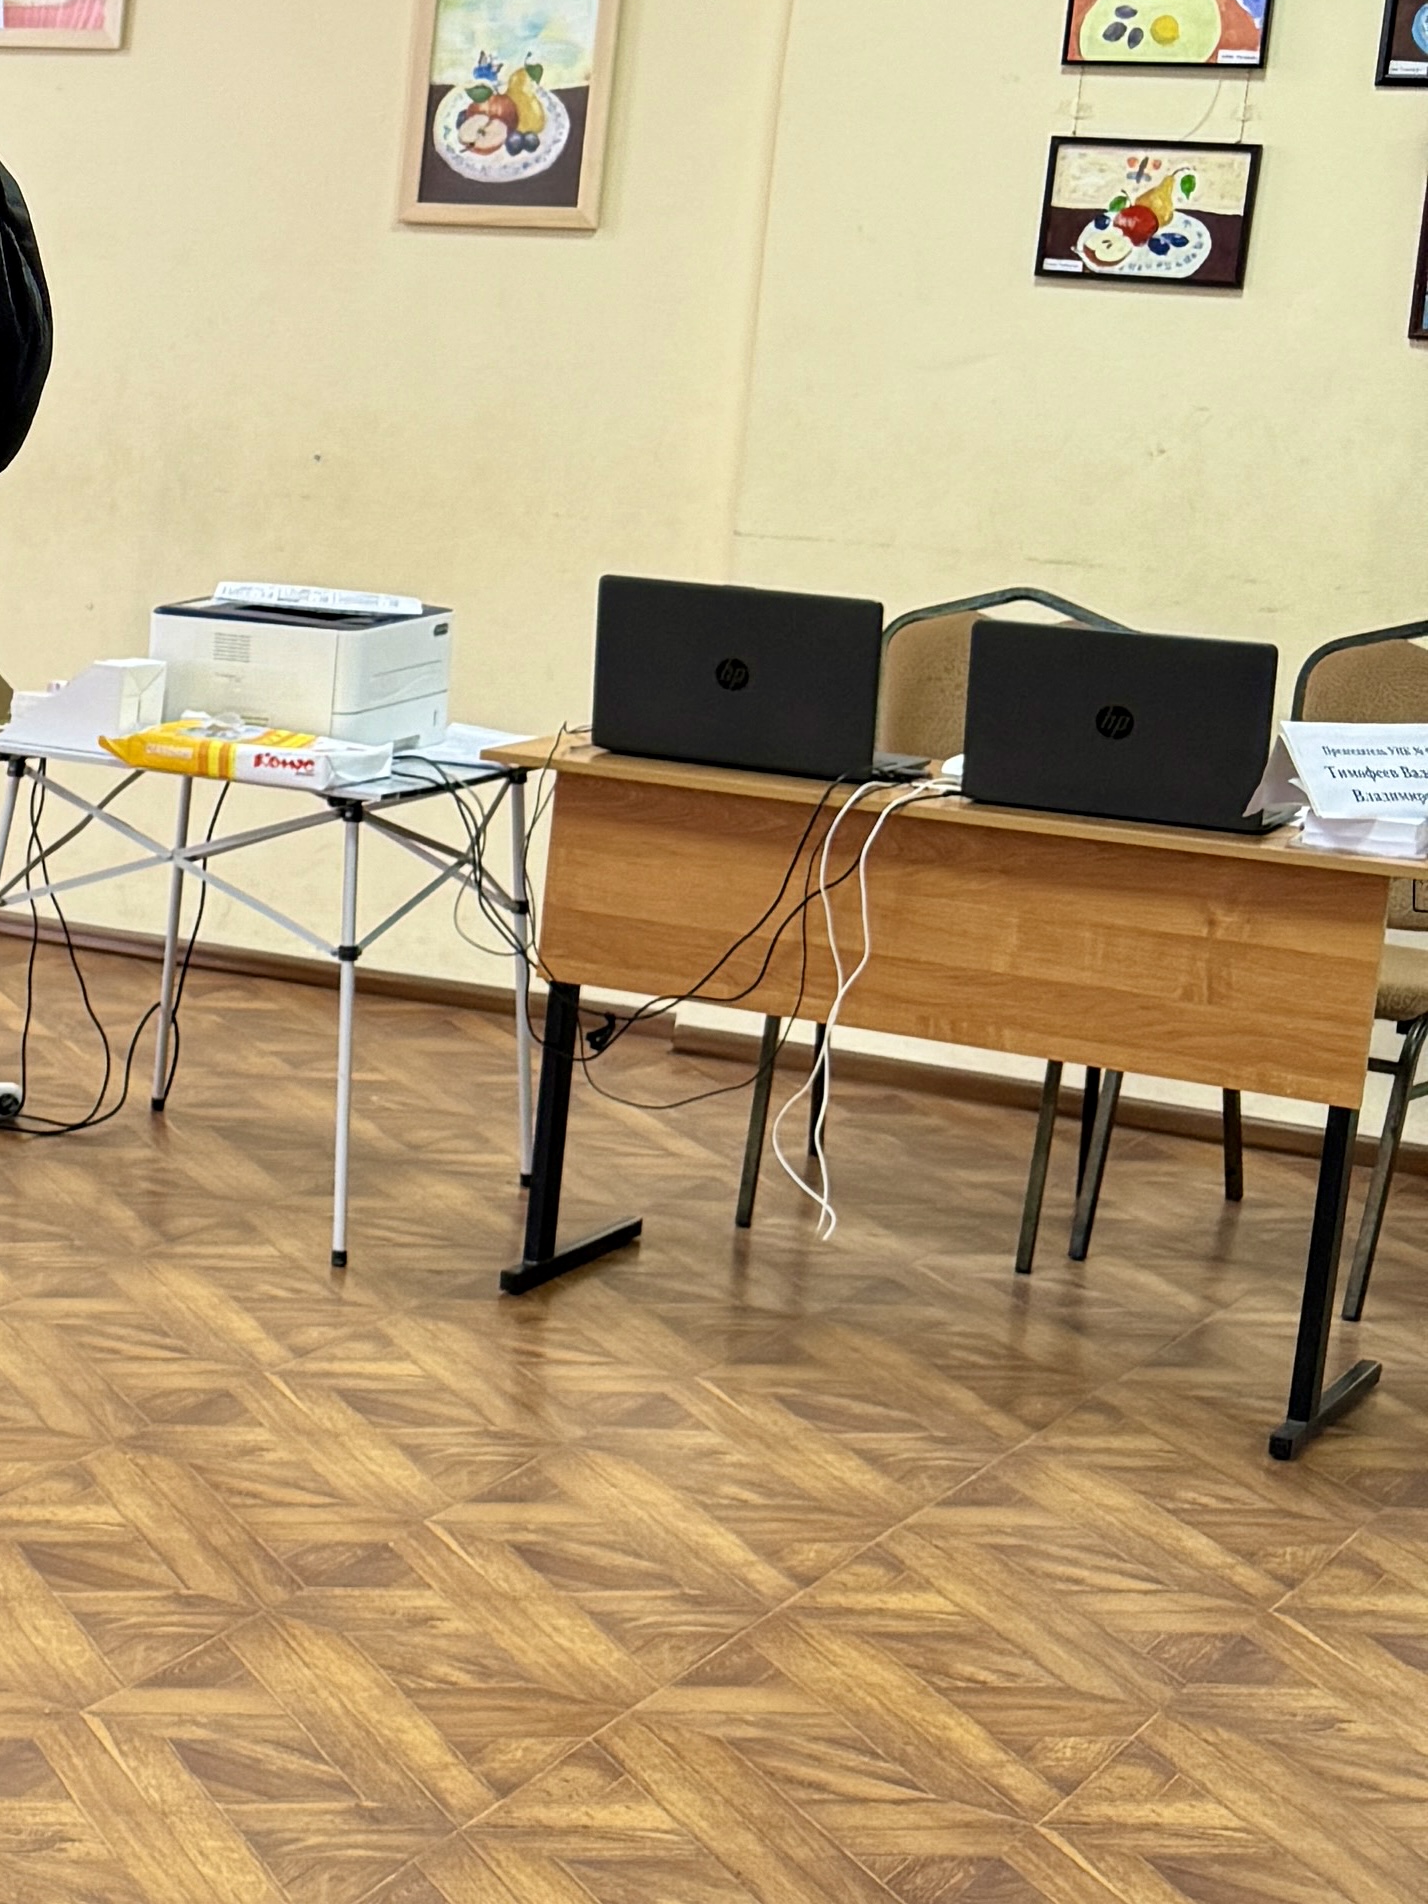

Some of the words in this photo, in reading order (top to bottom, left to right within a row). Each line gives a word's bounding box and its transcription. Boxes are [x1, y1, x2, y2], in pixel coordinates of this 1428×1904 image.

[718, 658, 748, 691] hp
[1099, 705, 1132, 740] hp
[1324, 765, 1399, 783] Тимофеев
